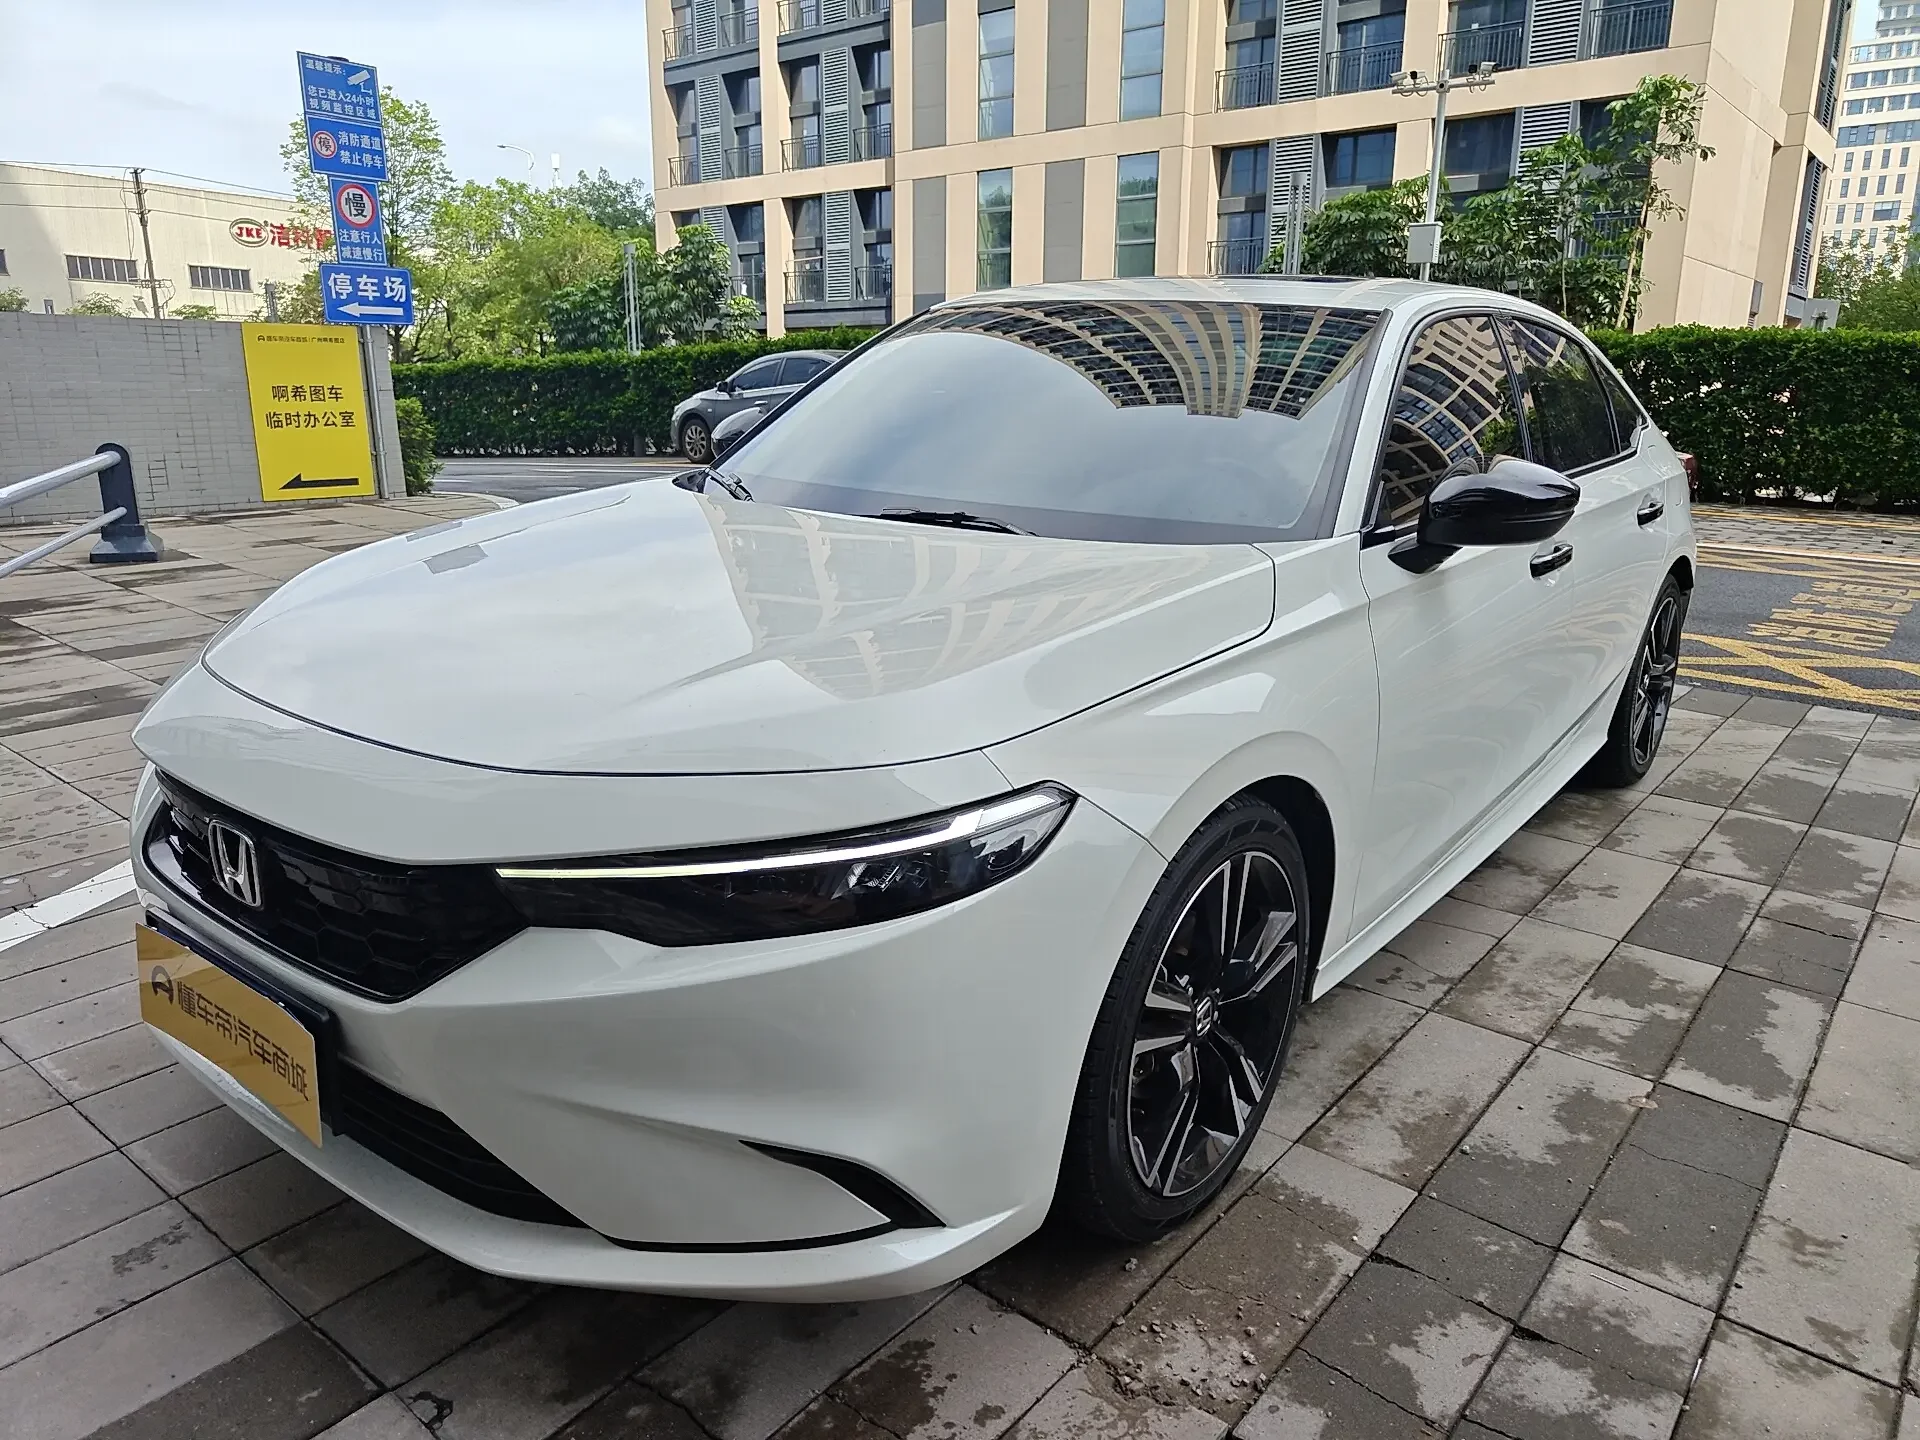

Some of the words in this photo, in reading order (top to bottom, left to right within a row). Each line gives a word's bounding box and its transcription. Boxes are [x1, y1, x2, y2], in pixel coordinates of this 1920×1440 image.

[308, 85, 375, 107] 您已进入24小时
[309, 98, 376, 119] 视频监控区域
[338, 131, 382, 150] 消防通道
[340, 150, 384, 169] 禁止停车
[345, 191, 367, 218] 慢
[235, 226, 263, 239] JKE
[339, 229, 382, 244] 注意行人
[341, 246, 383, 261] 减速慢行
[328, 273, 407, 303] 停车场
[272, 385, 344, 403] 啊希图车
[265, 411, 356, 430] 临时办公室
[176, 981, 309, 1102] 懂车帝汽车商城
